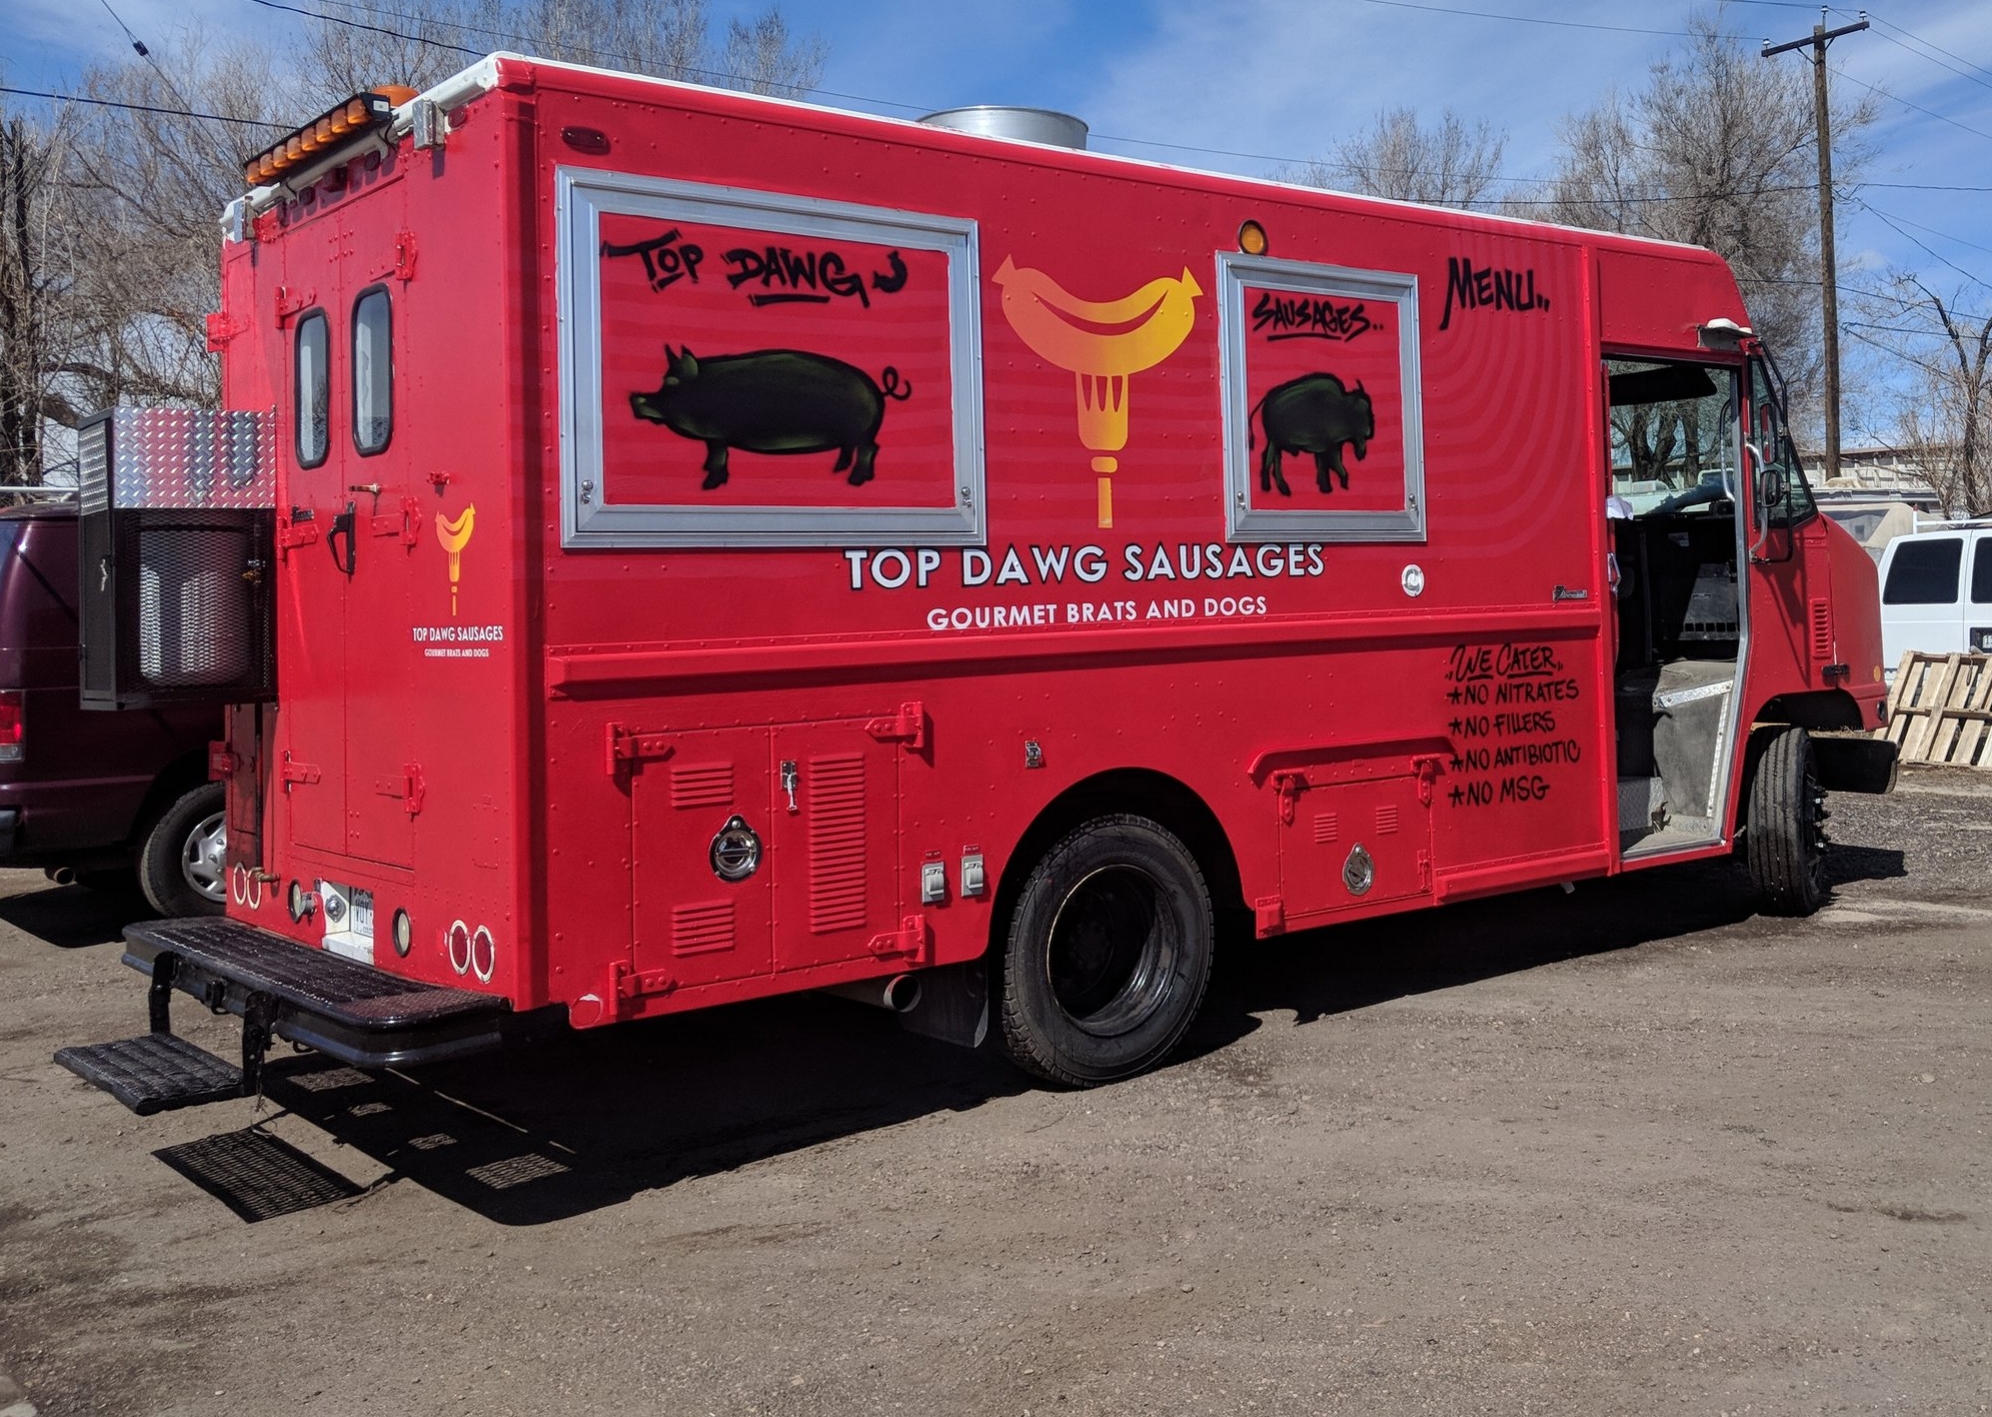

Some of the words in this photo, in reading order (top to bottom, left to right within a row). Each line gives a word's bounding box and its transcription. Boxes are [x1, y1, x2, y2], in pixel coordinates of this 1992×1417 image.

[600, 228, 704, 283] TOP
[720, 247, 870, 309] DAWG
[844, 547, 942, 590] TOP
[960, 543, 1108, 587] DAWG
[1122, 541, 1326, 581] SAUSAGES
[927, 604, 1058, 630] GOURMET
[1067, 600, 1136, 623] BRATS
[1145, 598, 1197, 620] AND
[1203, 595, 1268, 617] DOGS
[413, 627, 428, 641] TOP
[429, 626, 455, 641] DAWG
[457, 625, 503, 641] SAUSAGES
[424, 648, 446, 657] GOURMET
[446, 648, 461, 657] BRATS
[462, 648, 473, 657] AND
[473, 648, 489, 657] DOGS
[1495, 679, 1579, 705] NITRATES
[1493, 711, 1556, 737] FILLERS
[1494, 739, 1581, 769] ANTIBIOTIC
[1500, 775, 1550, 803] MSG
